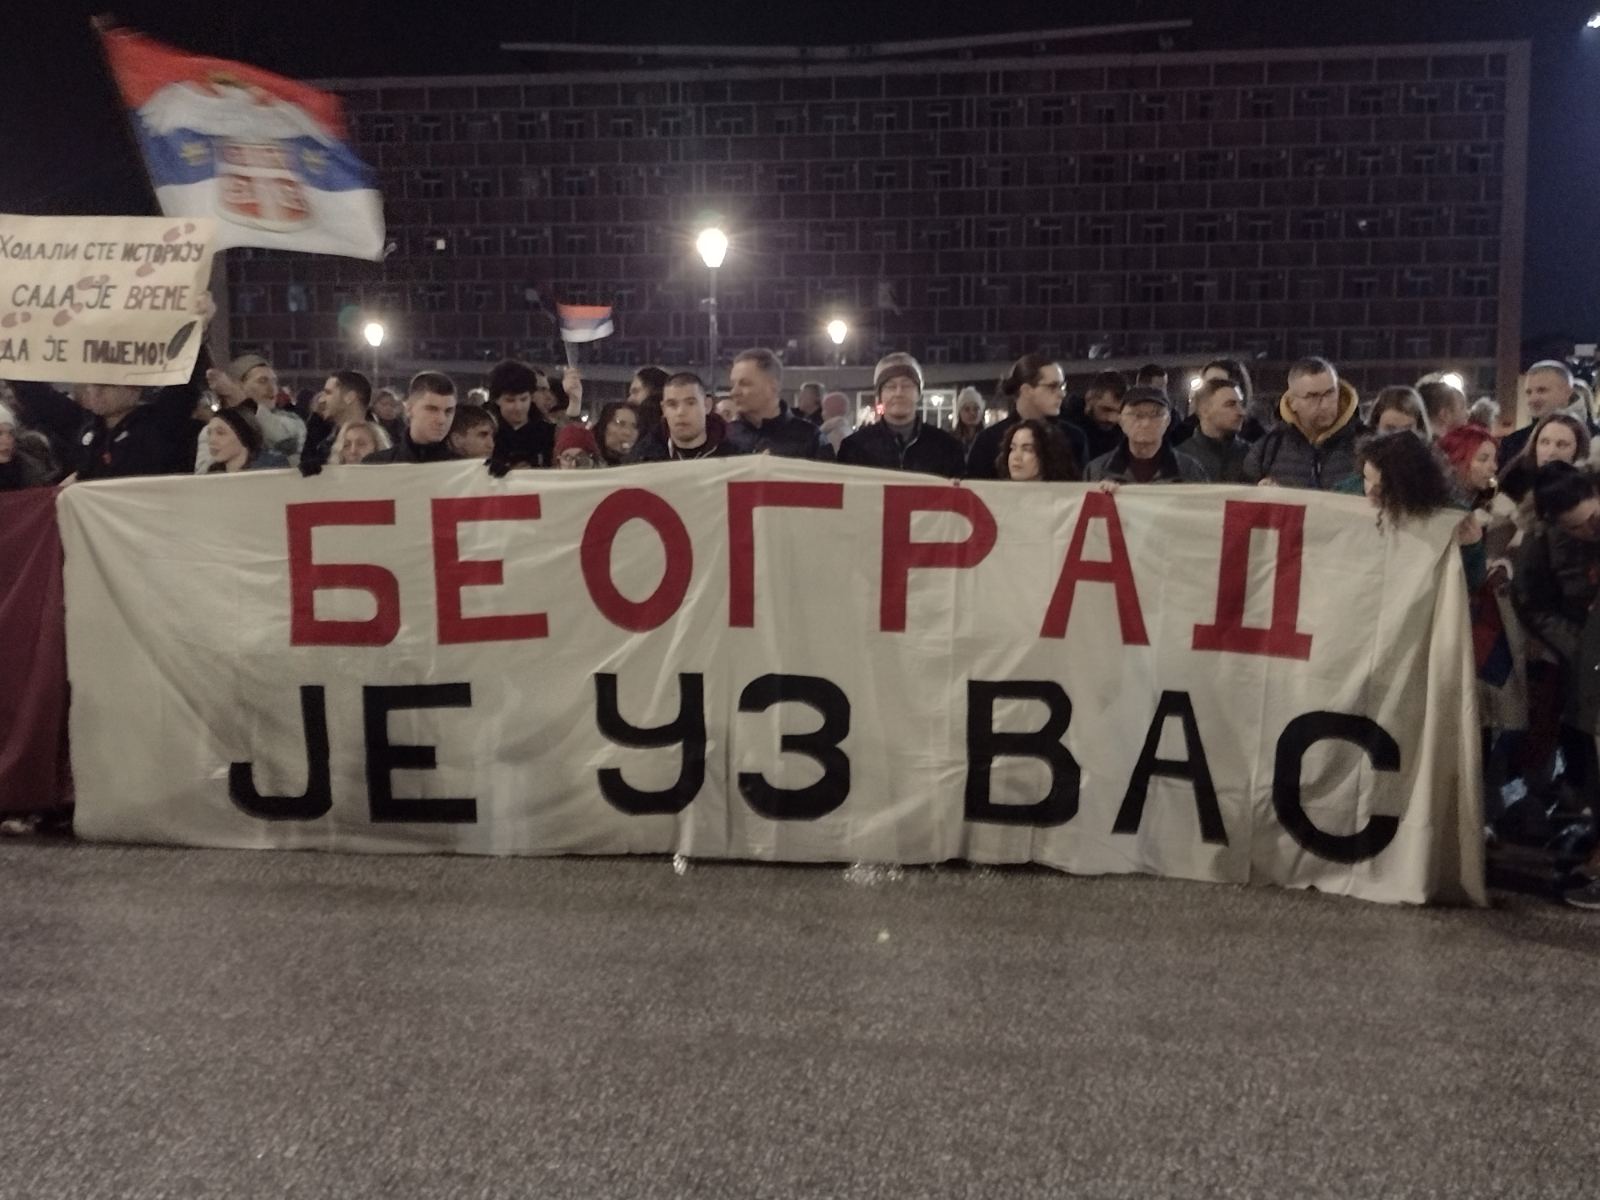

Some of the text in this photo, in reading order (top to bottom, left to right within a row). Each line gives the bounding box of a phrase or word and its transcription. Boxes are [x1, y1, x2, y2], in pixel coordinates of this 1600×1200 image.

[84, 242, 118, 260] СТЕ
[12, 284, 190, 310] САДА ЈЕ ВРЕМЕ
[0, 338, 29, 361] ДА
[43, 335, 68, 361] ЈЕ
[287, 481, 1312, 659] БЕОГРАД
[228, 671, 1402, 865] ЈЕ УЗ ВАС
